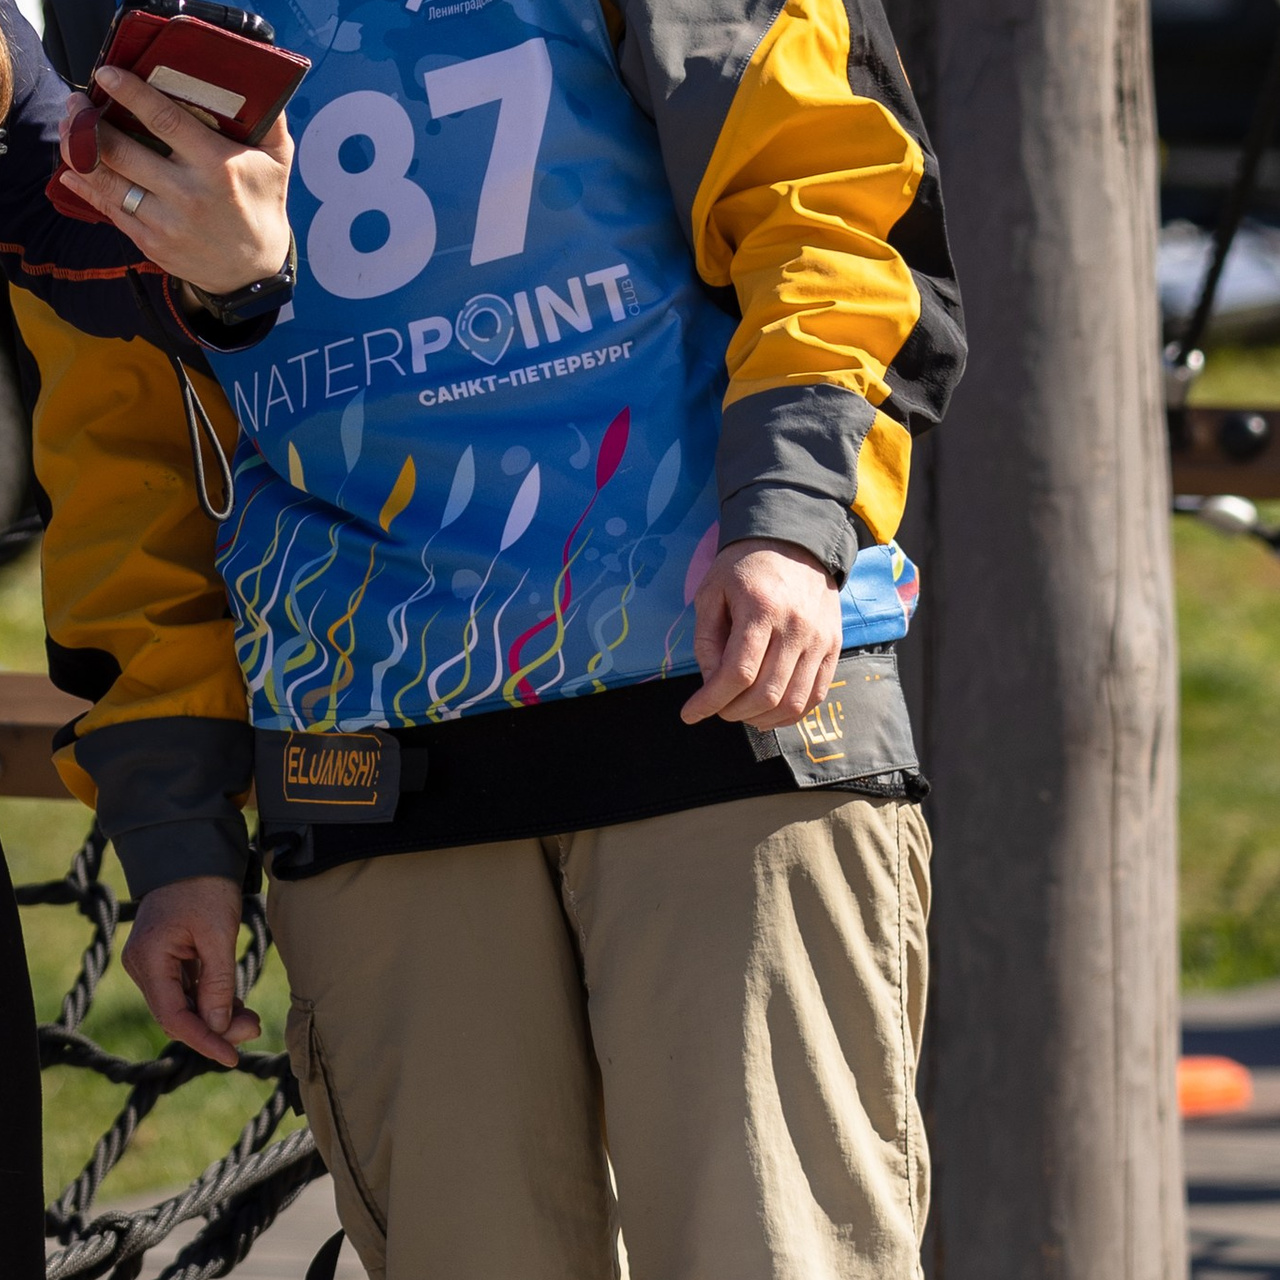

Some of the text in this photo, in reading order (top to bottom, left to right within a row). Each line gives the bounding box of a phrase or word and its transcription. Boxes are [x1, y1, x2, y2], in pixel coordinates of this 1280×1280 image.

[275, 37, 553, 326] 87
[621, 278, 640, 316] CLUB
[419, 341, 633, 406] САНКТ-ПЕТЕРБУРГ
